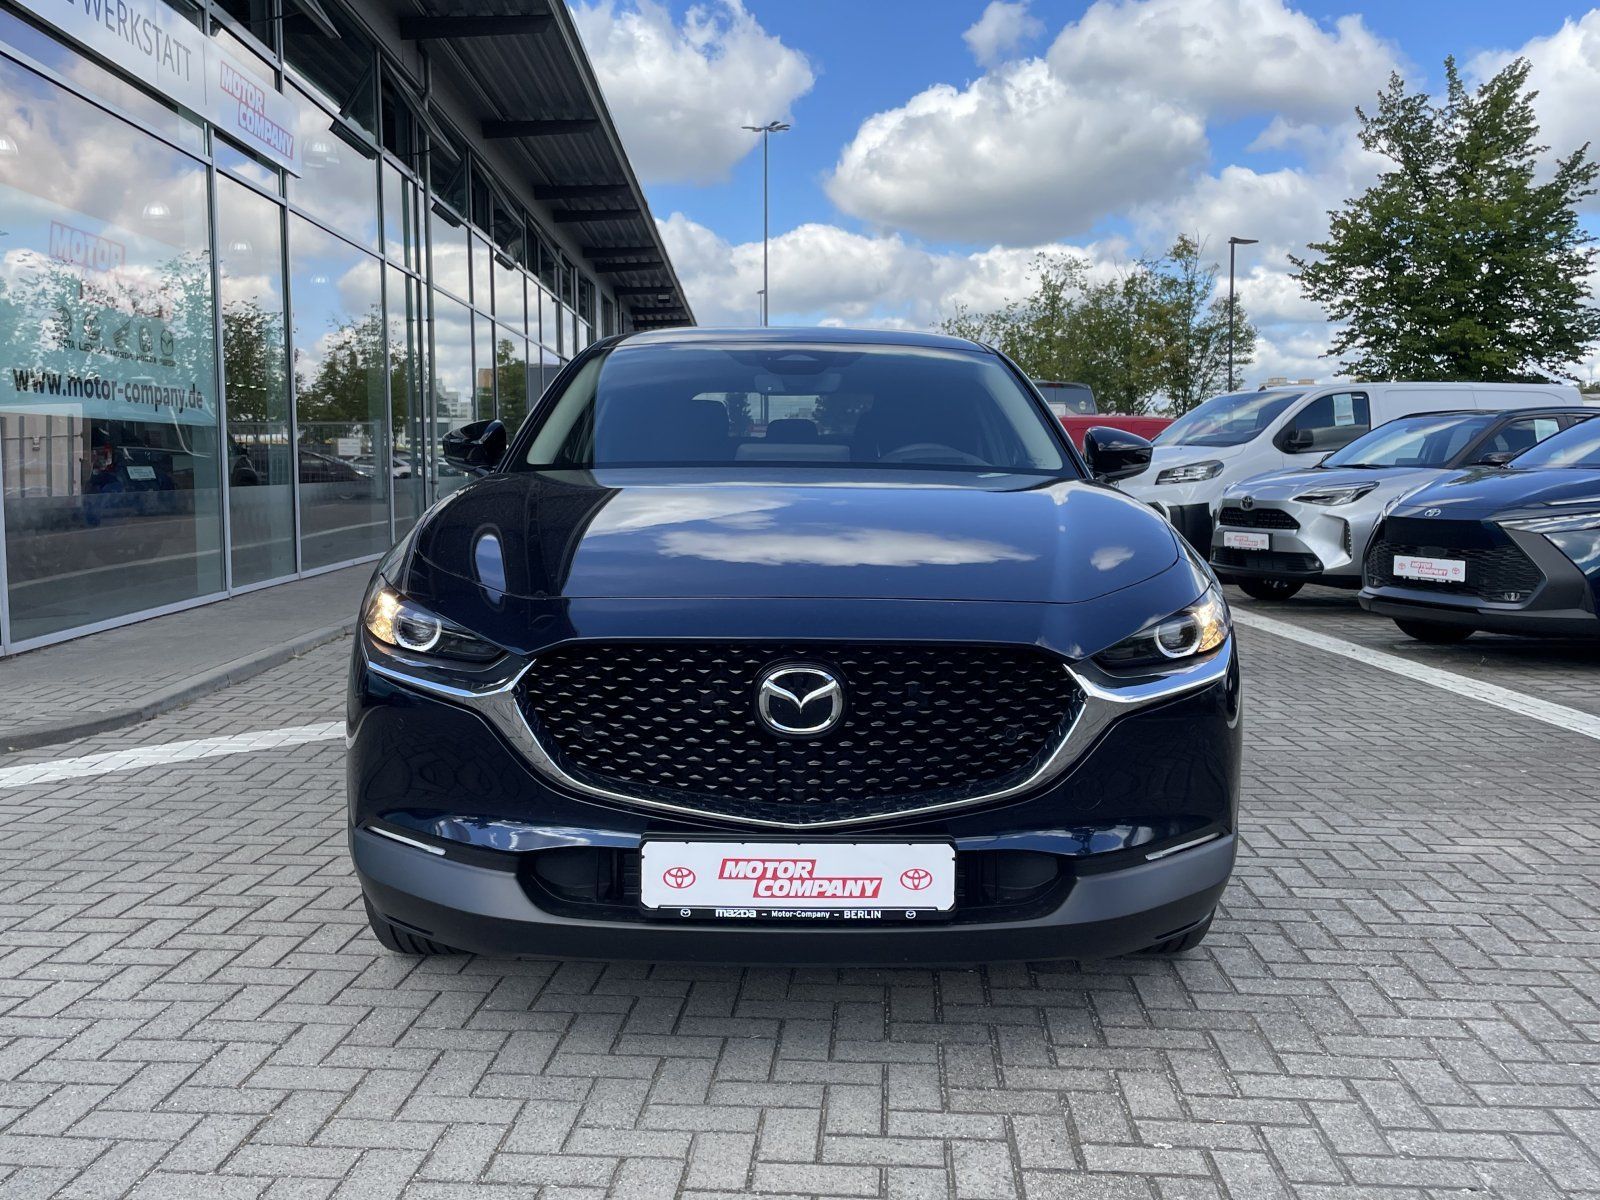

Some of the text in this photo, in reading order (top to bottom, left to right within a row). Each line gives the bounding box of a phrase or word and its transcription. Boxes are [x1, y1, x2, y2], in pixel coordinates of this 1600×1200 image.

[221, 62, 265, 115] MOTOR
[239, 103, 293, 159] COMPANY
[13, 368, 204, 413] www.motor-company.de
[722, 860, 813, 879] MOTOR
[757, 879, 881, 897] COMPANY
[771, 910, 830, 919] Motor-Company
[843, 910, 882, 919] BERLIN
